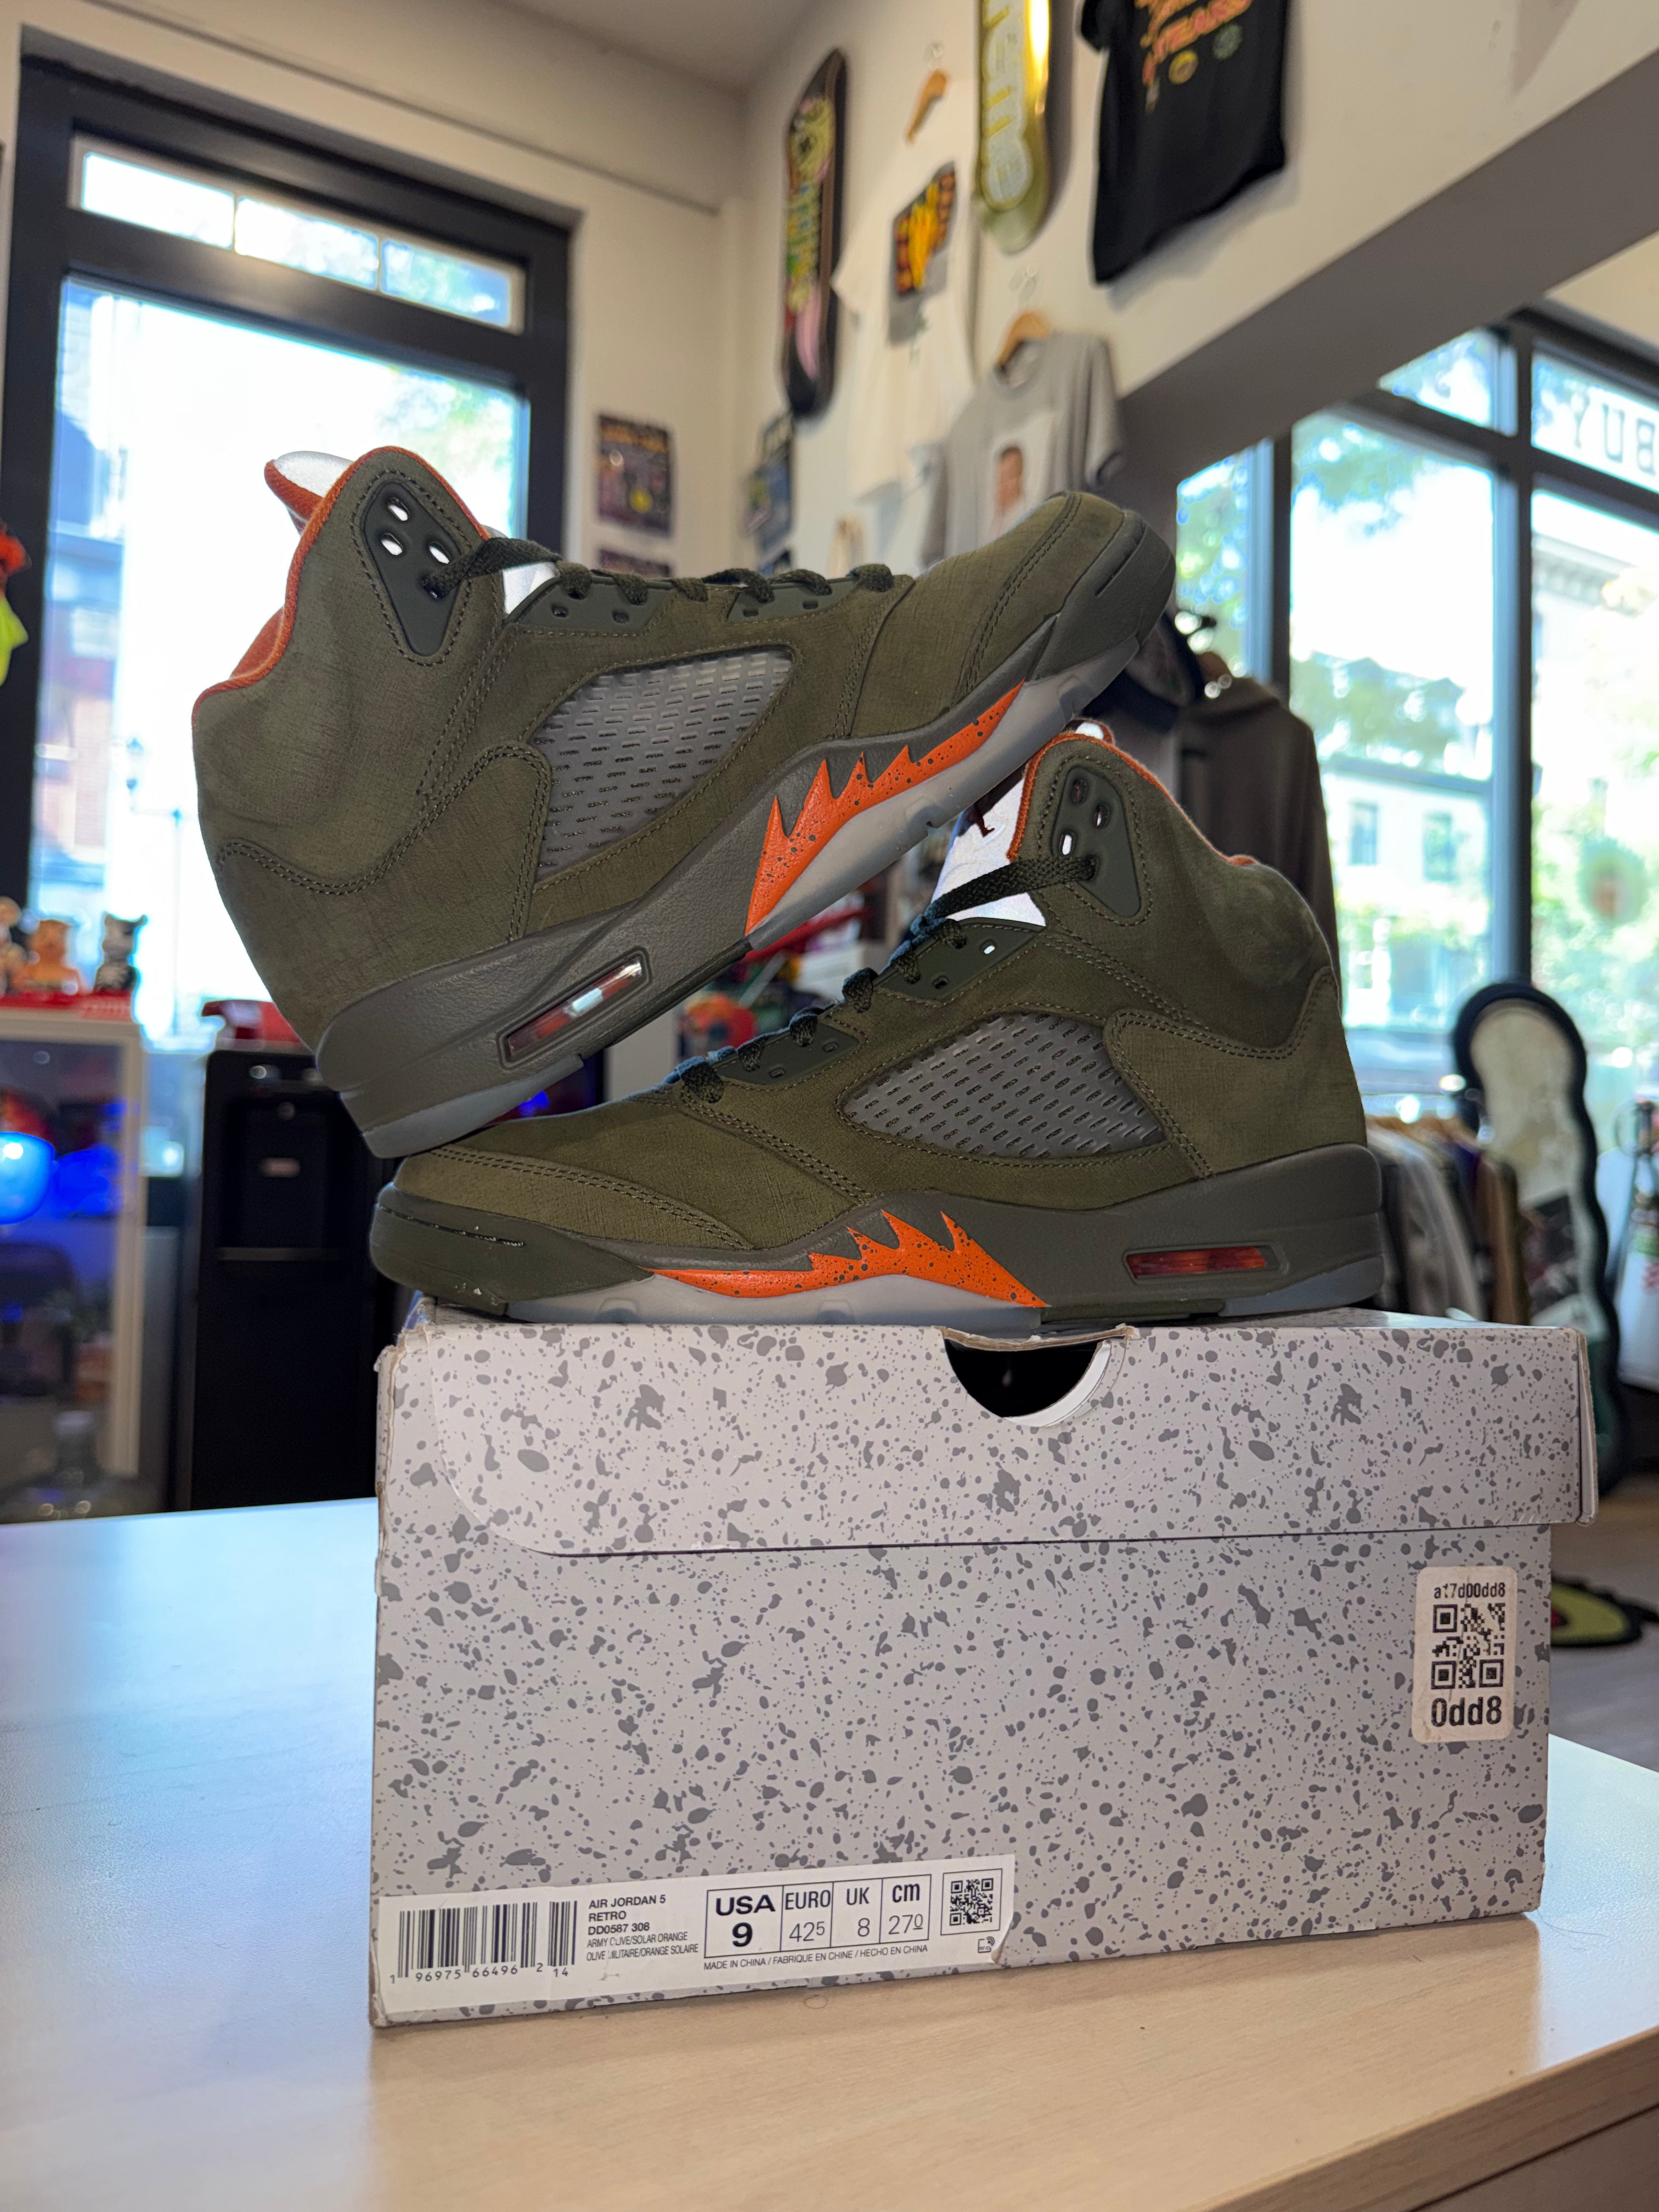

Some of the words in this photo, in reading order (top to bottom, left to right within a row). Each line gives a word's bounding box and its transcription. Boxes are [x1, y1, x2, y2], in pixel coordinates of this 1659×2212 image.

[1434, 1582, 1505, 1599] a17d00dd8
[1431, 1695, 1502, 1726] 0dd8
[589, 1899, 608, 1909] AIR
[611, 1895, 656, 1908] JORDAN
[659, 1894, 666, 1904] 5
[785, 1890, 831, 1910] EURO
[846, 1887, 870, 1905] UK
[892, 1883, 920, 1903] cm
[715, 1894, 776, 1916] USA
[589, 1910, 627, 1922] RETRO
[588, 1923, 628, 1935] DD0587
[631, 1922, 650, 1932] 308
[732, 1922, 753, 1947] 9
[789, 1921, 825, 1943] 425
[857, 1918, 870, 1937] 8
[587, 1937, 608, 1948] ARMY
[658, 1932, 688, 1943] ORANGE
[586, 1951, 606, 1961] OLIVE
[670, 1944, 699, 1954] SOLAIRE
[704, 1960, 727, 1970] MADE
[730, 1960, 738, 1968] IN
[740, 1957, 765, 1967] CHINA
[773, 1954, 813, 1964] FABRIQUE
[815, 1953, 826, 1961] EN
[828, 1950, 853, 1960] CHINE
[860, 1947, 888, 1957] HECHO
[890, 1946, 901, 1954] EN
[903, 1944, 928, 1954] CHINA
[390, 1974, 395, 1984] 1
[415, 1969, 461, 1982] 96975
[472, 1965, 517, 1978] 66496
[536, 1962, 543, 1972] 2
[554, 1967, 568, 1977] 14
